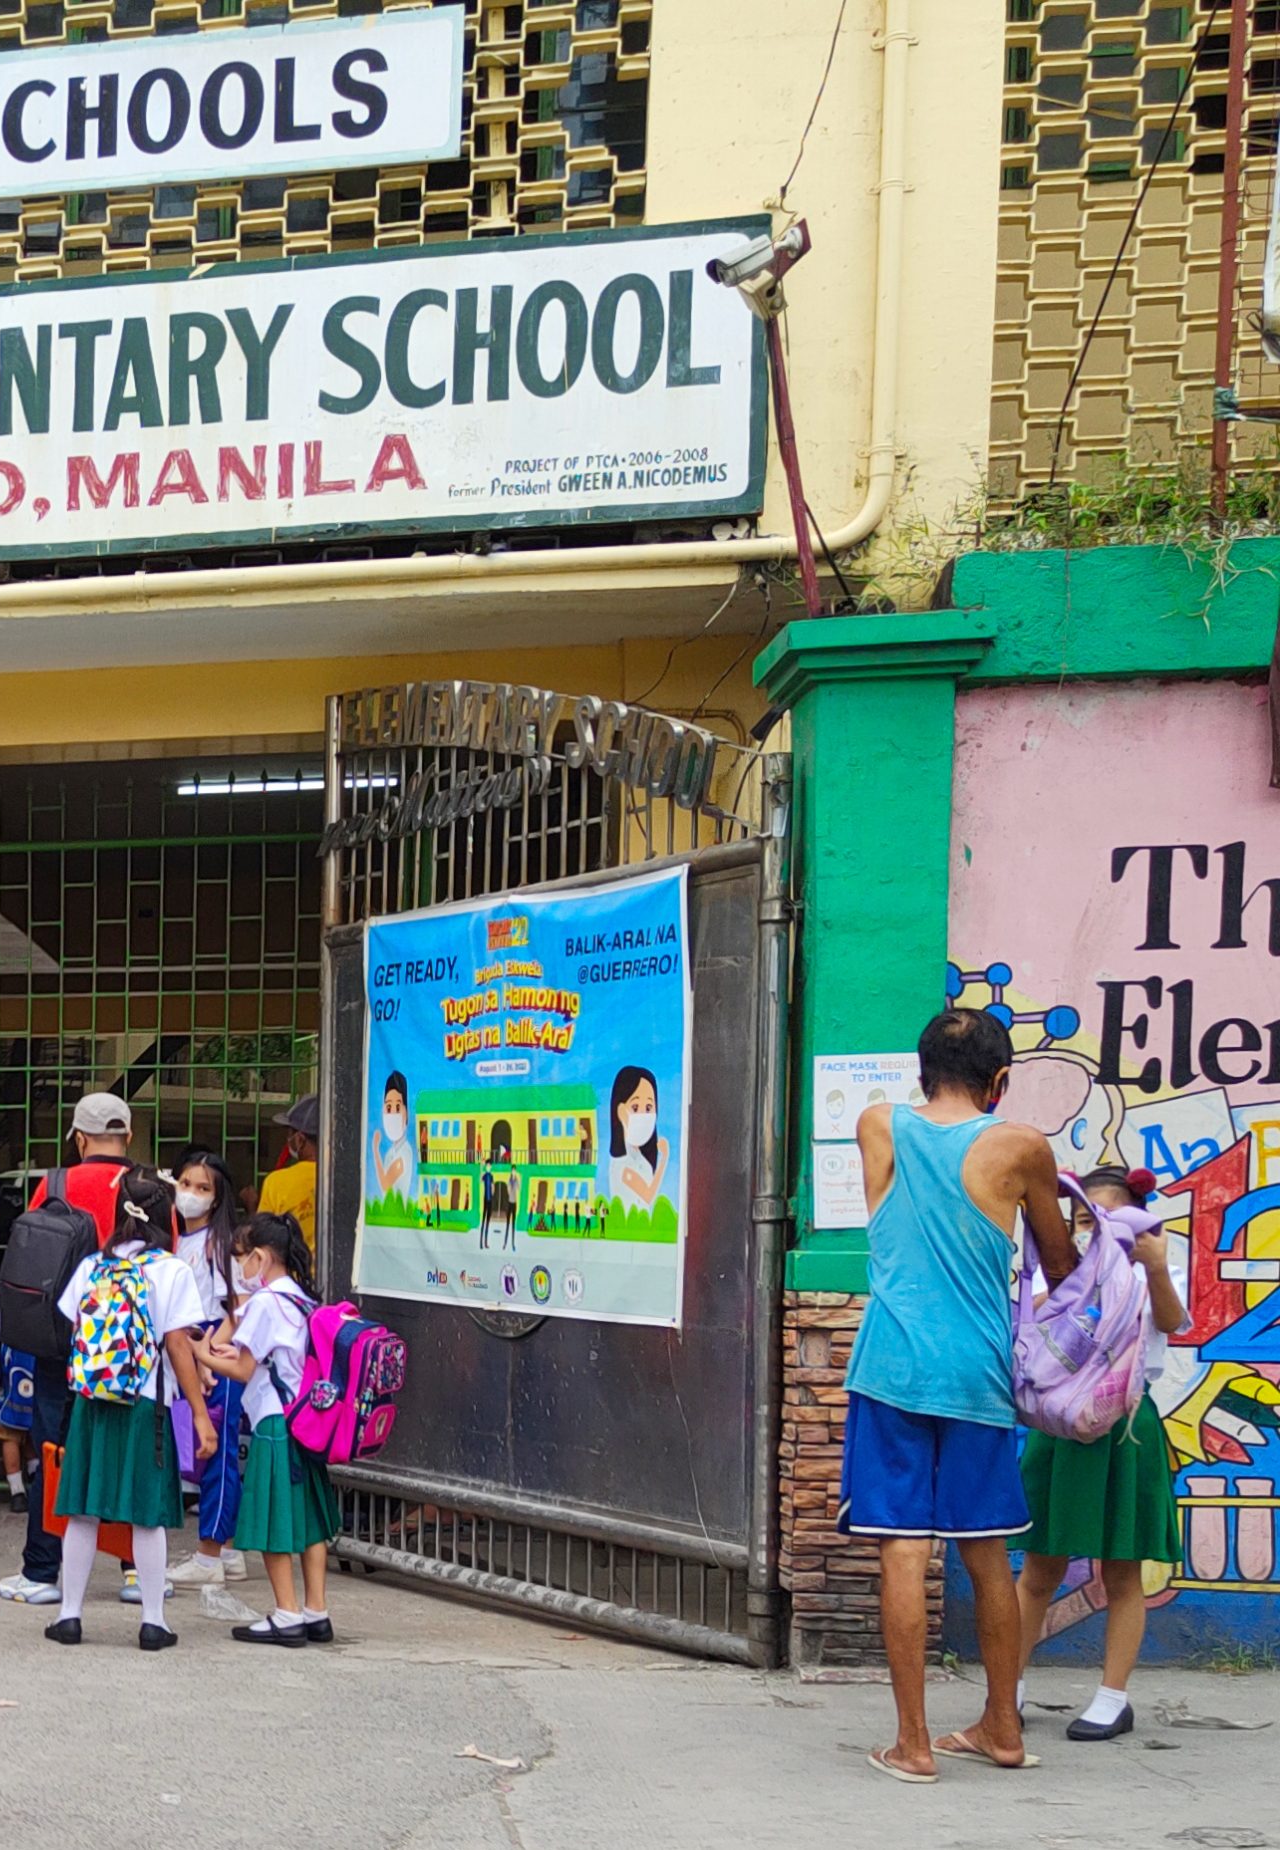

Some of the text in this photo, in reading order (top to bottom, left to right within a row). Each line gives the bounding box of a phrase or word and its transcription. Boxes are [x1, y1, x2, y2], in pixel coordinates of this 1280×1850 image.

[318, 271, 721, 414] SCHOOL
[66, 433, 427, 512] MANILA
[505, 458, 558, 474] PROJECT
[563, 456, 579, 470] OF
[448, 484, 485, 498] former
[490, 477, 551, 497] President
[558, 471, 616, 493] GWEEN
[565, 922, 677, 957] BALIK-ARAL NA
[374, 955, 459, 988] GET READY,
[577, 953, 679, 985] @GUERRERO!
[374, 997, 401, 1022] GO!
[440, 981, 581, 1027] Tugon sa Hamon ng
[444, 1017, 576, 1062] Ligtas na Balik-Aral
[820, 1062, 846, 1072] FACE
[849, 1061, 878, 1070] MASK
[852, 1072, 902, 1083] TO ENTER
